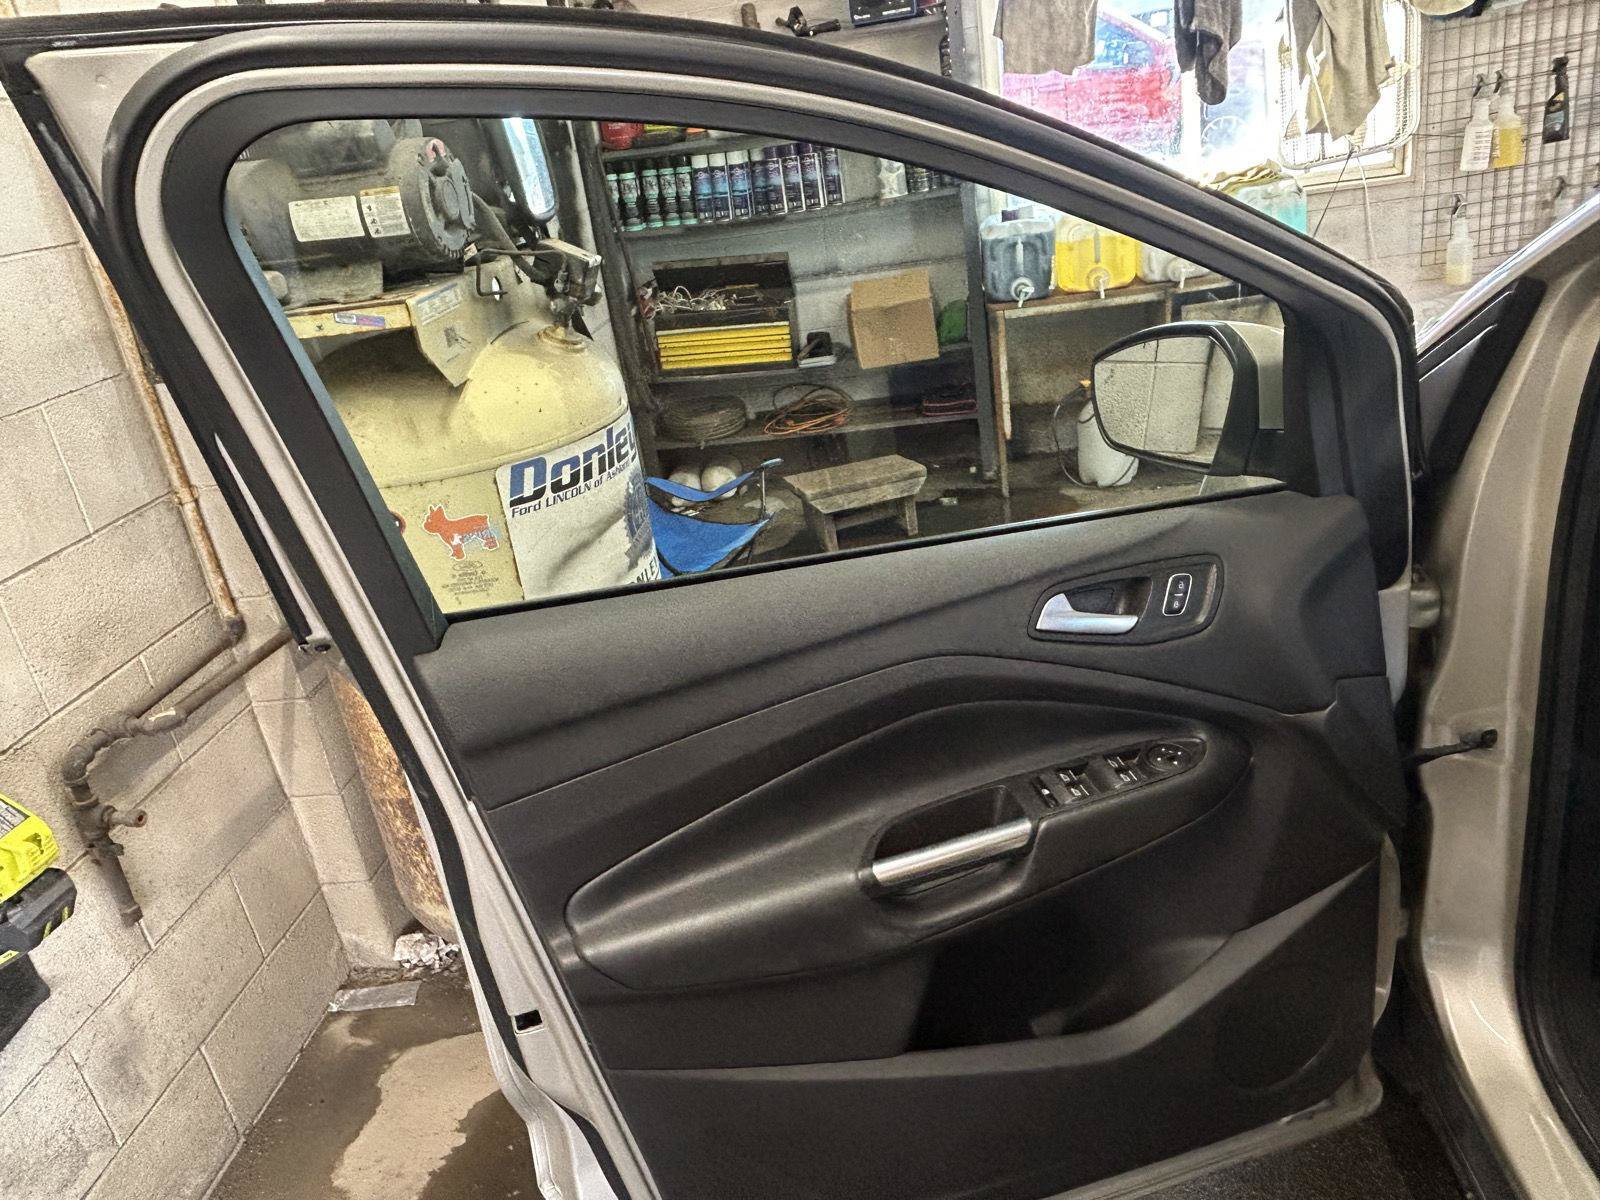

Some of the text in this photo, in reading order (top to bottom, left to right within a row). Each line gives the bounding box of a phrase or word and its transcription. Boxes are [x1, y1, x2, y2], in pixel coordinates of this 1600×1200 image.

[509, 422, 638, 508] Donley
[511, 501, 541, 518] Ford
[546, 482, 592, 508] LINCOLN
[594, 475, 604, 488] of
